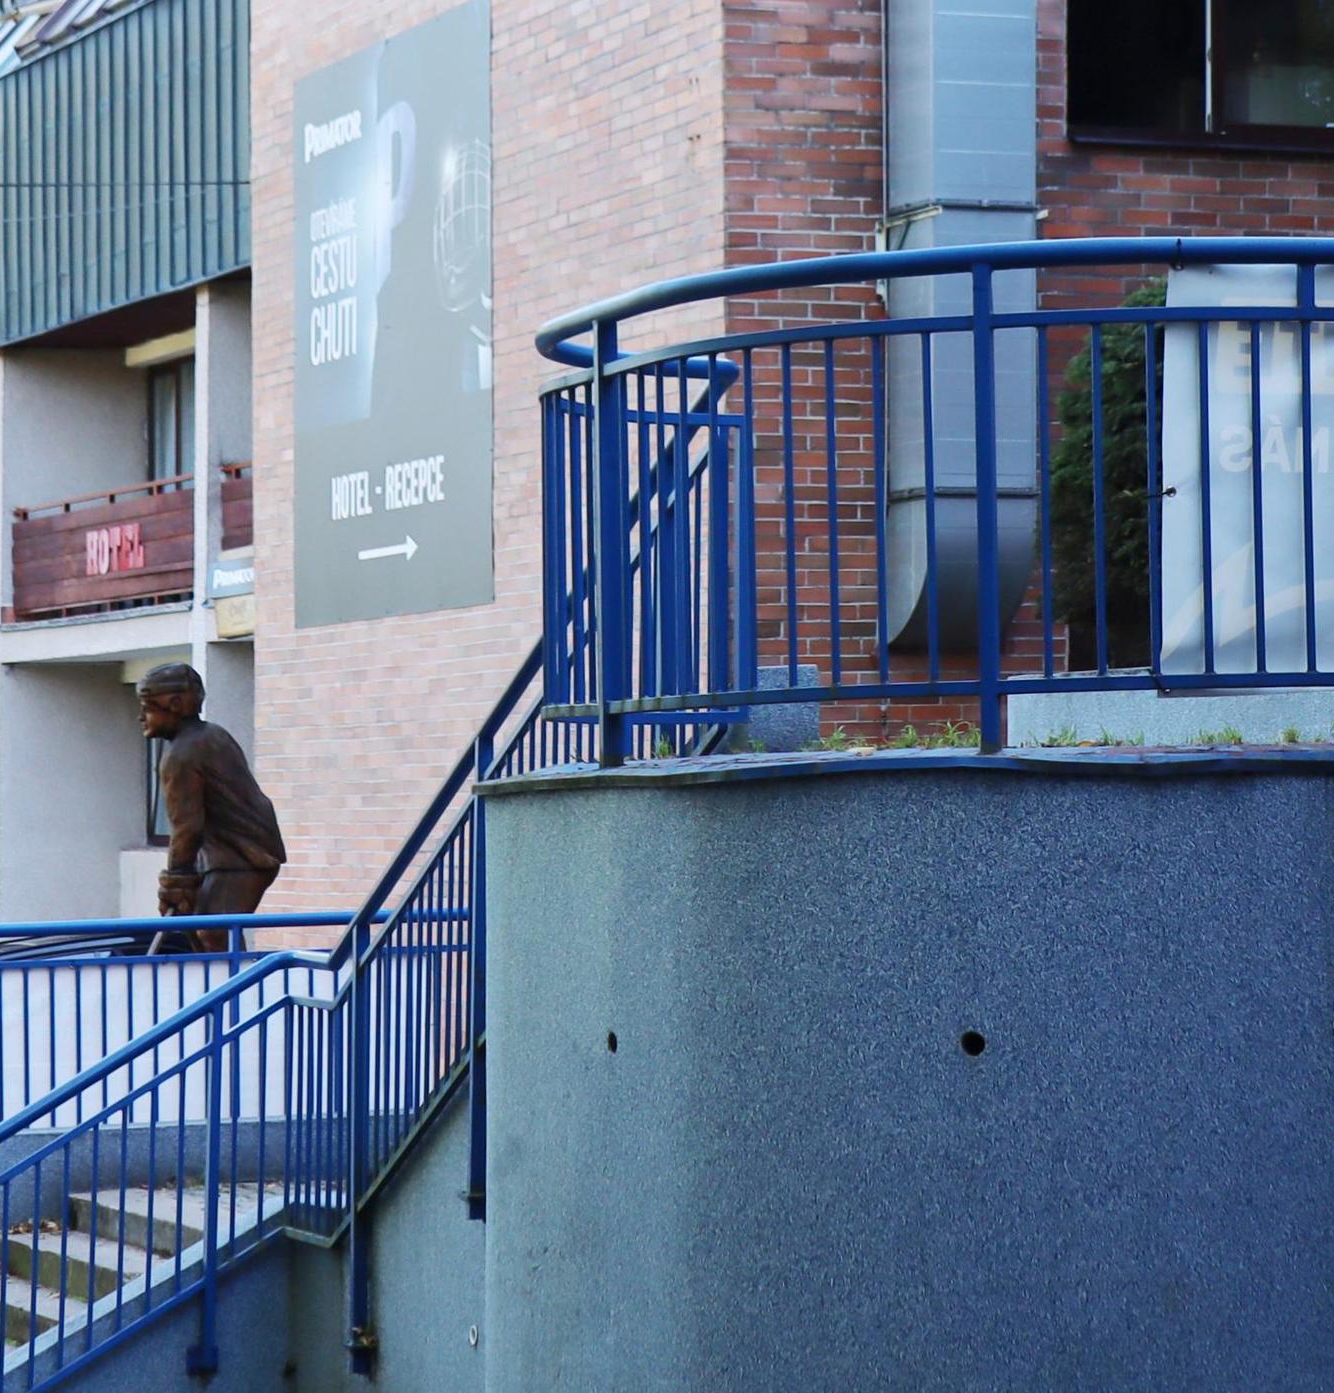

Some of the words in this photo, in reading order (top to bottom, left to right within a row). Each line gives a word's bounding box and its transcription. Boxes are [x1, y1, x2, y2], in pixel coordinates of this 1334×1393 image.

[310, 235, 358, 299] CESTU
[310, 295, 357, 367] CHUTI
[331, 470, 373, 521] HOTEL
[385, 454, 445, 511] RECEPCE
[85, 522, 144, 576] HOTEL
